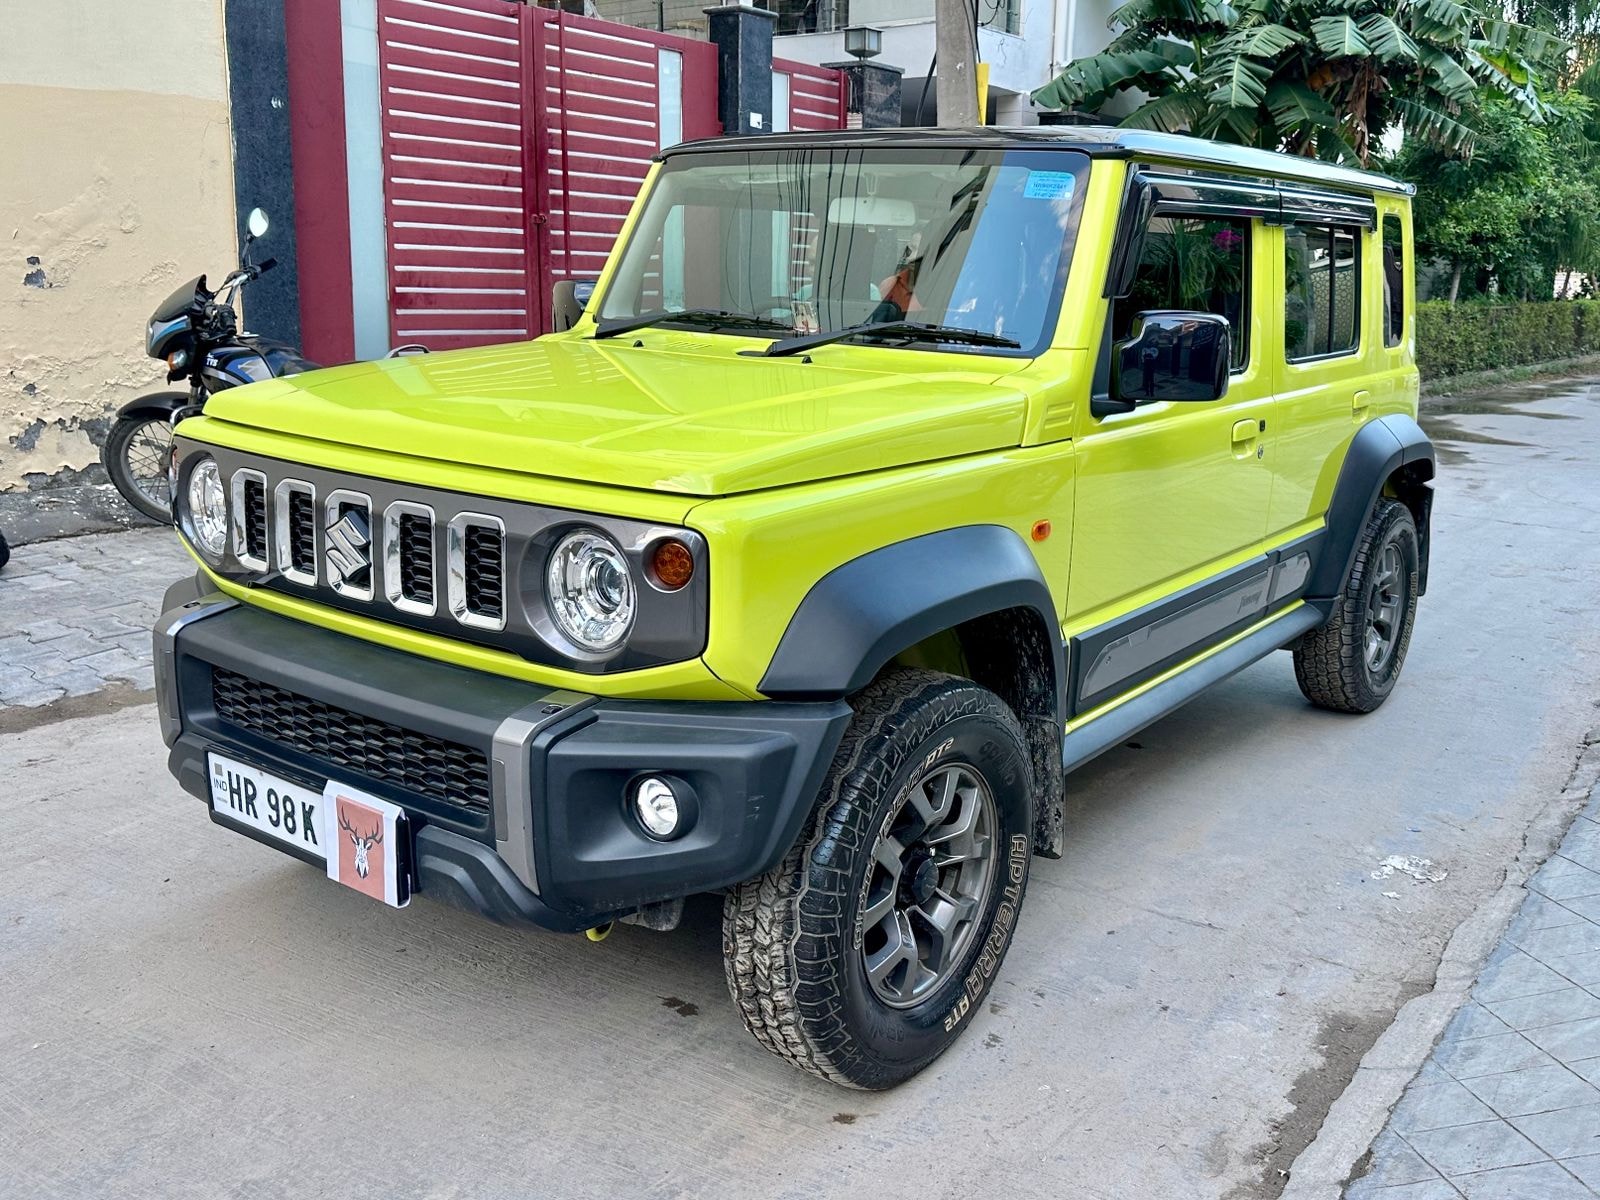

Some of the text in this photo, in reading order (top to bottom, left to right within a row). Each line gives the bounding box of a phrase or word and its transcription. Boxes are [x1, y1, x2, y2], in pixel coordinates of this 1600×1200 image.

[206, 358, 218, 366] TVS
[213, 777, 227, 792] IND
[227, 771, 318, 846] HR 98 K
[945, 834, 1028, 1032] APTERRA AT2
